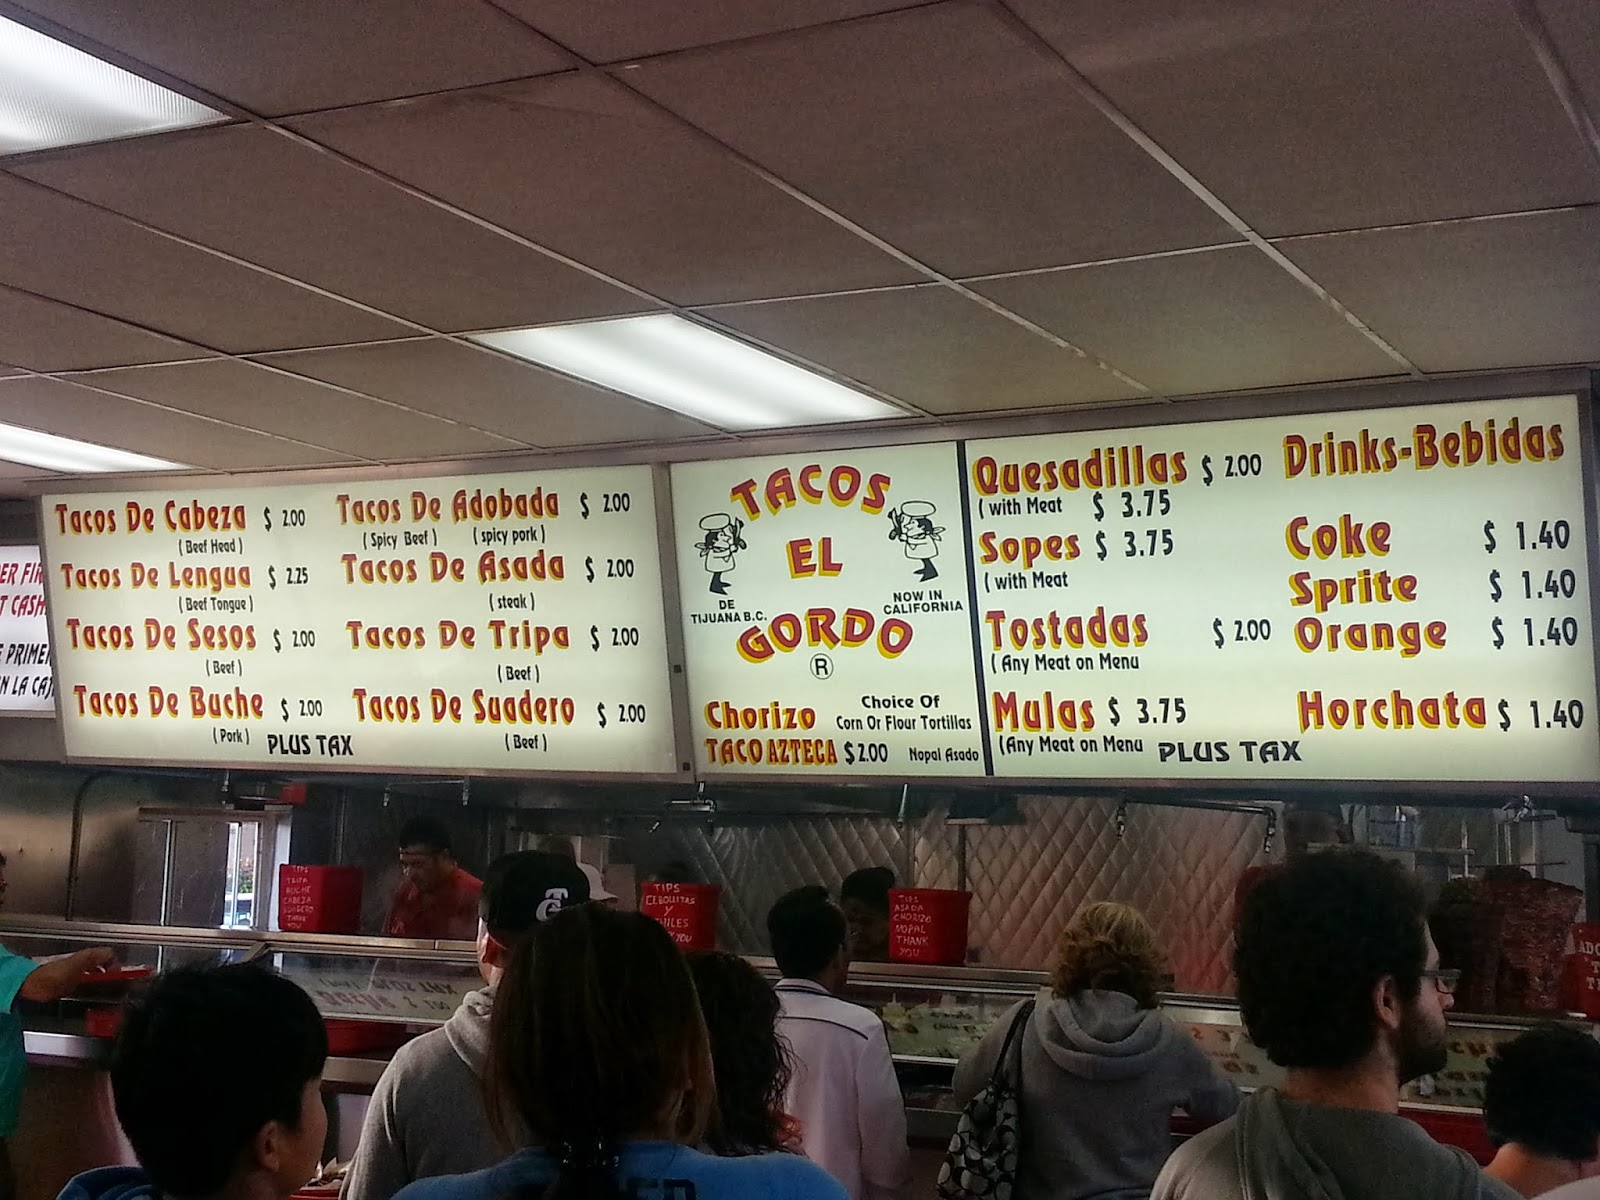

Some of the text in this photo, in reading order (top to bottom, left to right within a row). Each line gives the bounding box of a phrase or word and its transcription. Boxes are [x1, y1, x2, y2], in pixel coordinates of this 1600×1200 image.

[1283, 417, 1564, 479] Drinks-Bebidas
[972, 445, 1261, 496] Quesadillas $ 2.00
[336, 487, 630, 525] Tacos De Adobada $ 2.00
[730, 465, 891, 521] TACOS
[1027, 497, 1062, 514] Meat
[1093, 491, 1105, 521] $
[1121, 489, 1171, 517] 3.75
[55, 500, 305, 534] Tacos De Cabeza $ 2.00
[978, 529, 1173, 569] Sopes $ 3.75
[1285, 514, 1570, 560] Coke $ 1.40
[341, 550, 634, 584] Tacos De Asada $ 2.00
[786, 537, 843, 578] EL
[61, 561, 308, 593] Tacos De Lengua $ 2.25
[1033, 571, 1069, 589] Meat
[1289, 569, 1575, 613] Sprite $ 1.40
[11, 595, 46, 617] CASH
[719, 600, 735, 610] DE
[883, 601, 963, 614] CALIFORNIA
[893, 590, 942, 602] NOW IN
[691, 611, 767, 623] TIJUANA B.C.
[985, 606, 1271, 651] Tostadas $ 2.00
[66, 618, 315, 653] Tacos De Sesos $ 2.00
[346, 620, 639, 655] Tacos De Tripa $ 2.00
[737, 608, 913, 663] GORDO
[1294, 617, 1578, 658] Orange $ 1.40
[1035, 654, 1071, 670] Meat
[1076, 656, 1093, 670] on
[1100, 652, 1139, 670] Menu
[12, 676, 29, 696] LA
[74, 685, 322, 722] Tacos De Buche $ 2.00
[353, 689, 645, 728] Tacos De Suadero $ 2.00
[705, 701, 815, 729] Chorizo
[861, 695, 939, 709] Choice Of
[993, 691, 1186, 732] Mulas $ 3.75
[1298, 690, 1584, 733] Horchata $ 1.40
[836, 715, 972, 730] Corn Or Flour Tortillas
[267, 734, 353, 757] PLUS TAX
[706, 739, 762, 765] TACO
[767, 739, 837, 765] AZTECA
[909, 747, 979, 763] Nopal Asado
[1038, 736, 1076, 752] Meat
[1081, 738, 1098, 752] on
[1103, 736, 1143, 752] Menu
[1158, 740, 1302, 763] PLUS TAX
[654, 883, 680, 893] TIPS
[895, 904, 923, 912] ASADA
[656, 918, 688, 928] HILES
[895, 925, 925, 934] NOPAL
[896, 935, 928, 945] THANK
[900, 947, 920, 957] YOU
